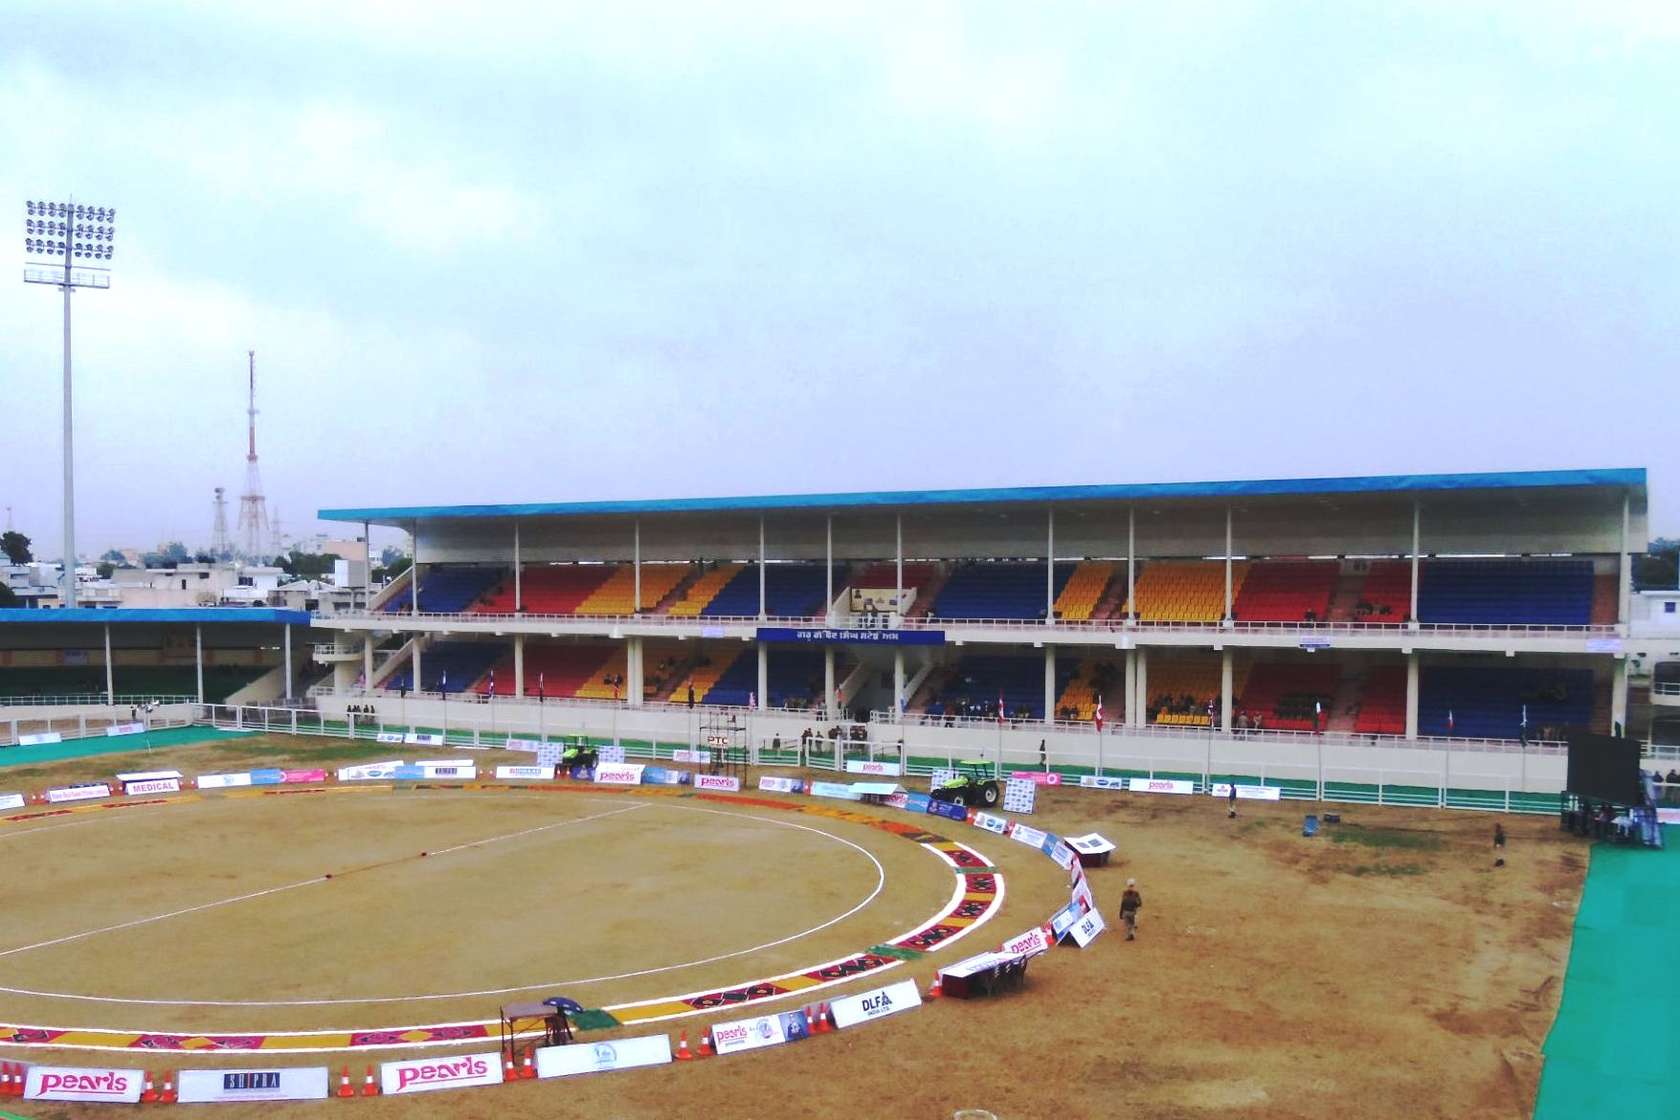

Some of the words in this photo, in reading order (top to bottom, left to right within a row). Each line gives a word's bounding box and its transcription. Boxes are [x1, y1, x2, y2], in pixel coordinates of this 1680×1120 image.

[133, 781, 174, 792] MEDICAL
[716, 1025, 748, 1041] pearls
[35, 1071, 127, 1097] pearls
[396, 1056, 488, 1092] pearls
